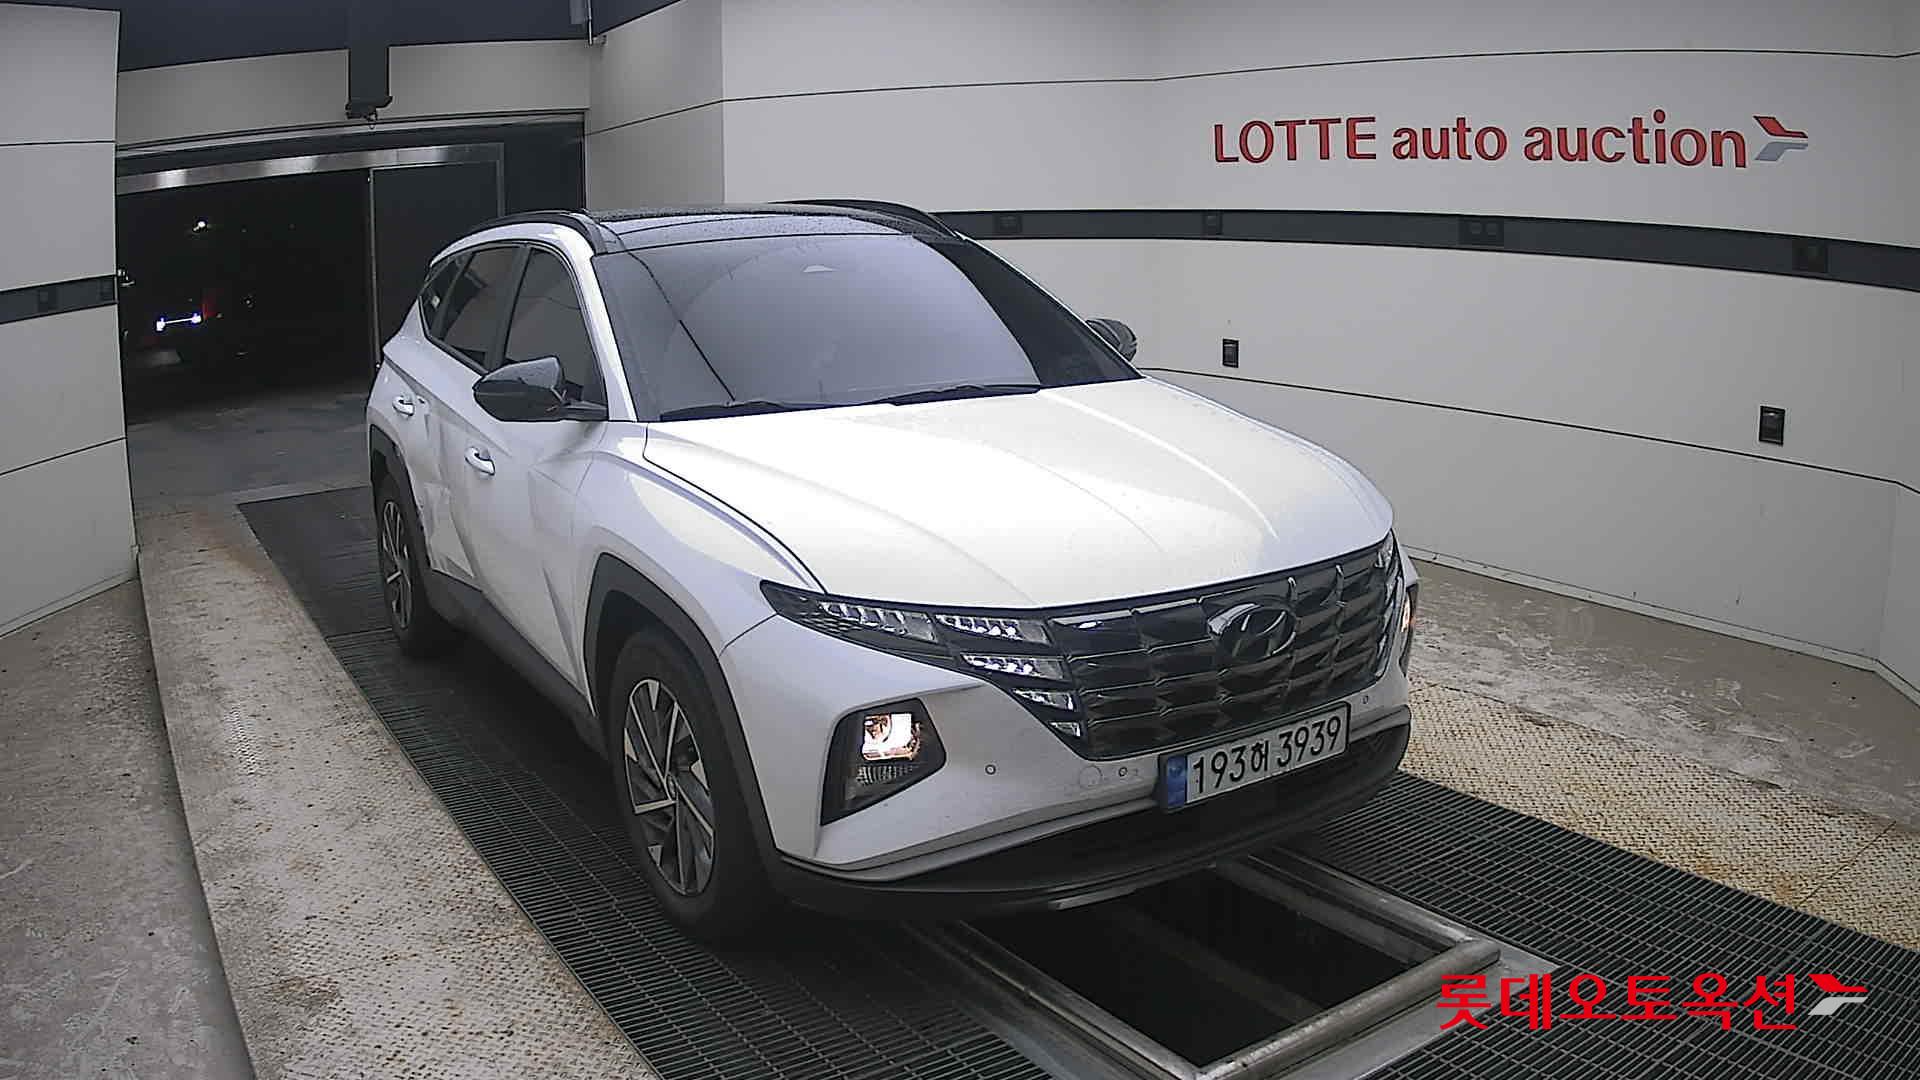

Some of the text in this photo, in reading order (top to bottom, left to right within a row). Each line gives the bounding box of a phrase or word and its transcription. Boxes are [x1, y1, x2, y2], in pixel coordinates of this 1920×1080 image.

[1213, 109, 1747, 169] LOTTE auto auction
[1277, 715, 1342, 768] 3939
